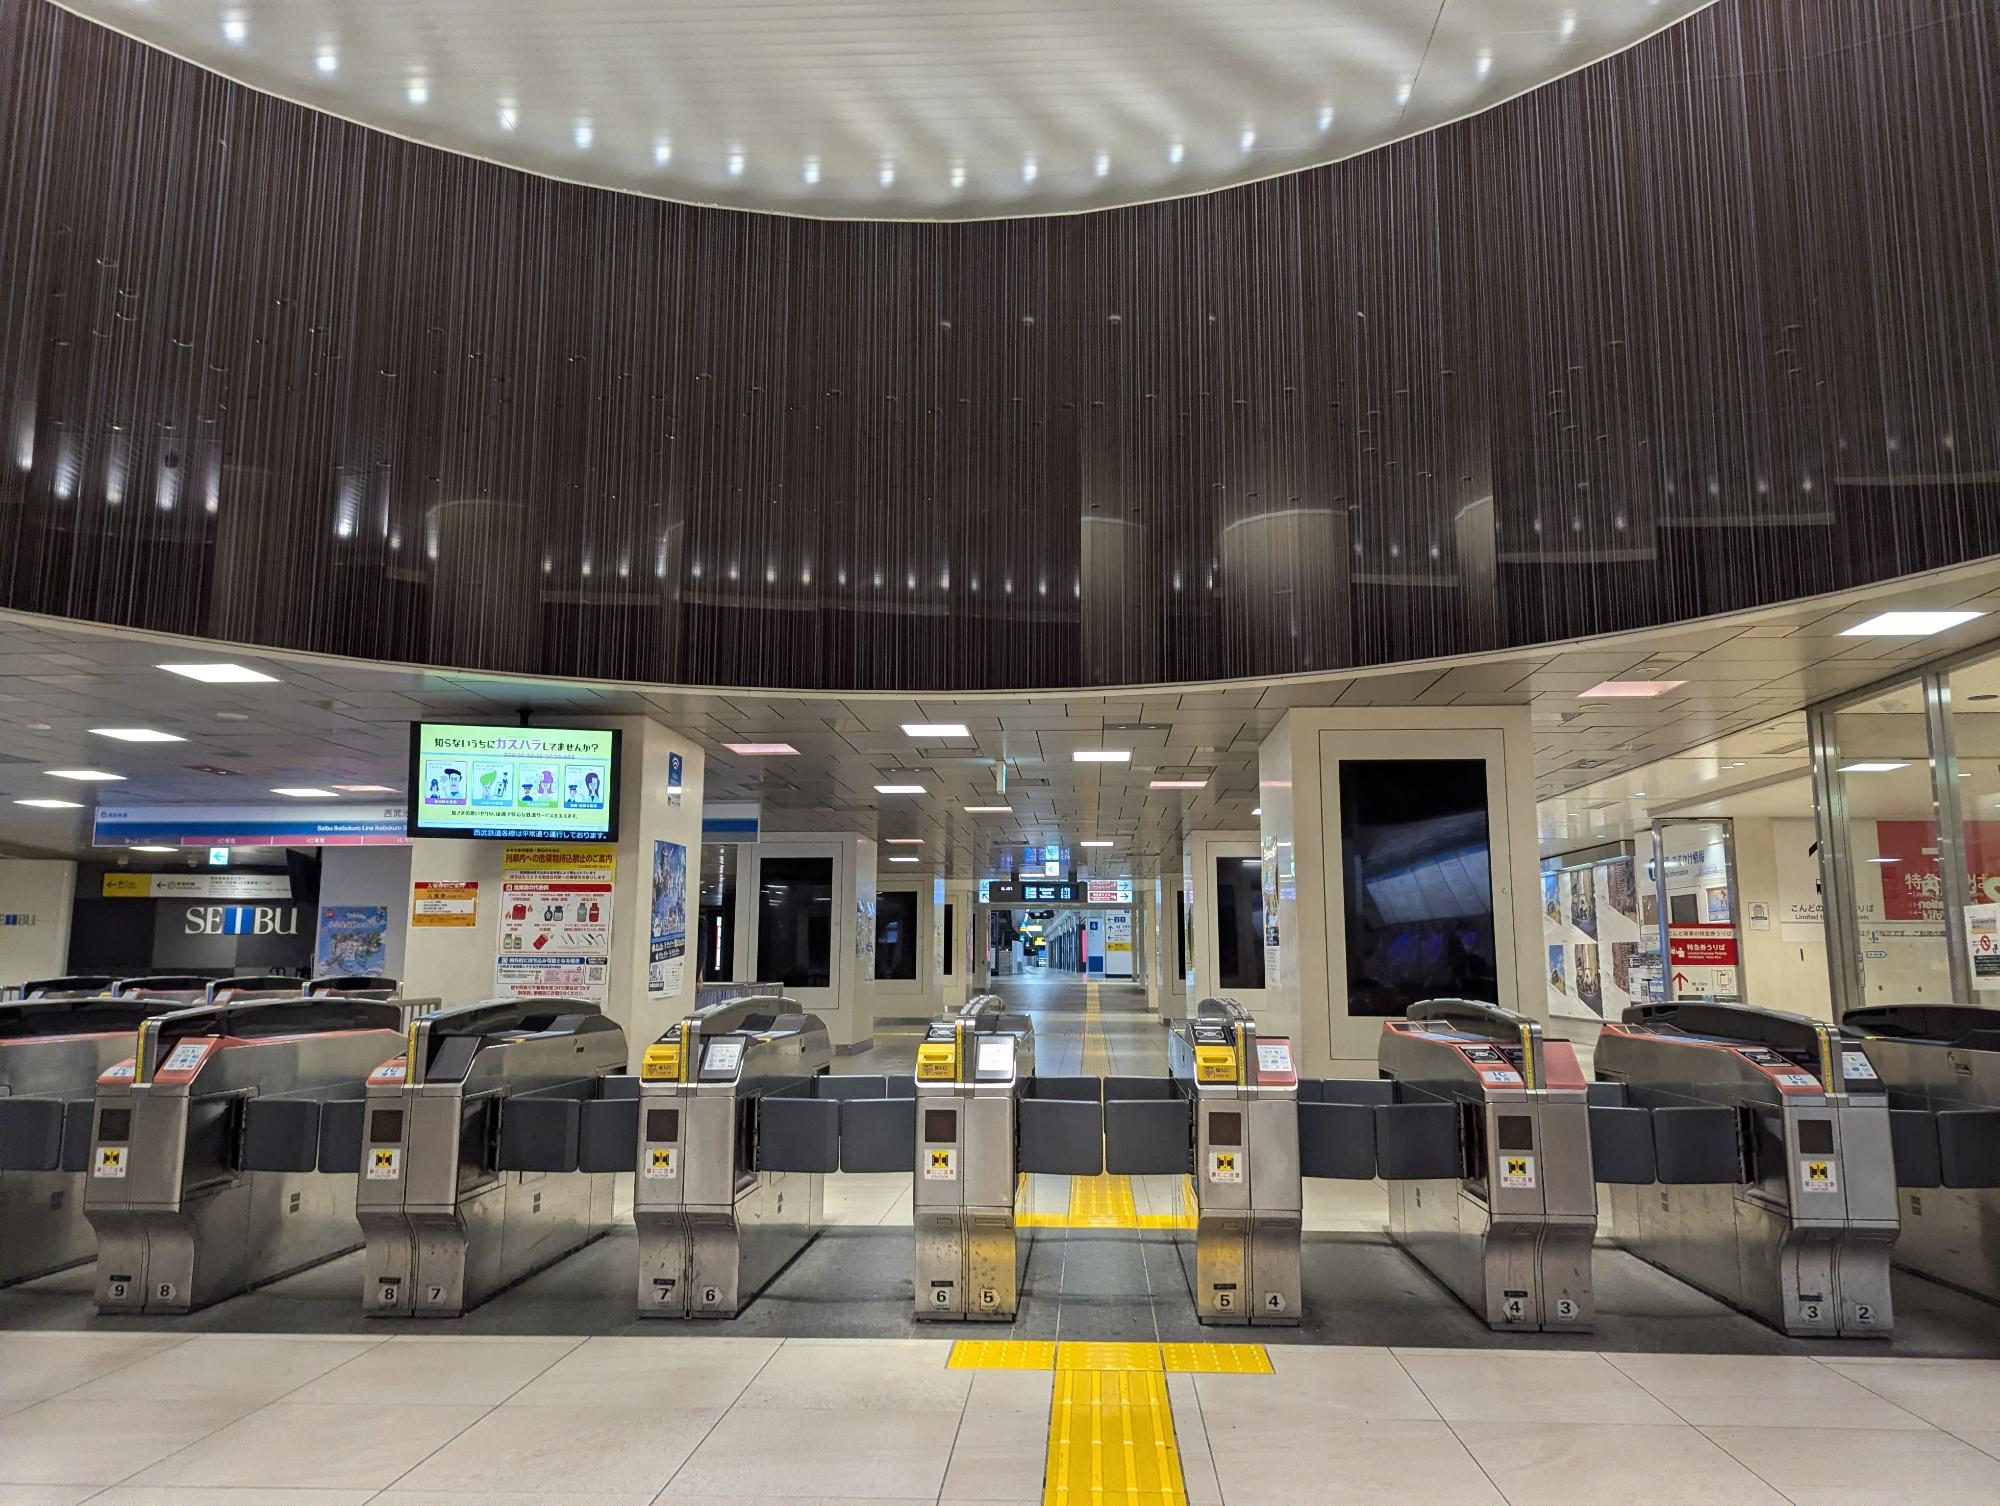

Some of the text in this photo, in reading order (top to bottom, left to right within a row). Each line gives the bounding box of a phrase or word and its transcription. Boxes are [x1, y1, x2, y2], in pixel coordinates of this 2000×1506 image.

[184, 907, 299, 935] SEIBU
[114, 1285, 124, 1297] 9
[160, 1285, 170, 1297] 8
[384, 1288, 394, 1300] 8
[432, 1288, 441, 1300] 7
[659, 1288, 669, 1300] 7
[705, 1289, 715, 1302] 6
[936, 1290, 946, 1302] 6
[983, 1291, 993, 1303] 5
[1220, 1295, 1231, 1307] 5
[1269, 1295, 1279, 1307] 4
[1510, 1301, 1520, 1313] 4
[1560, 1302, 1571, 1314] 3
[1807, 1306, 1818, 1319] 3
[1858, 1307, 1870, 1320] 2
